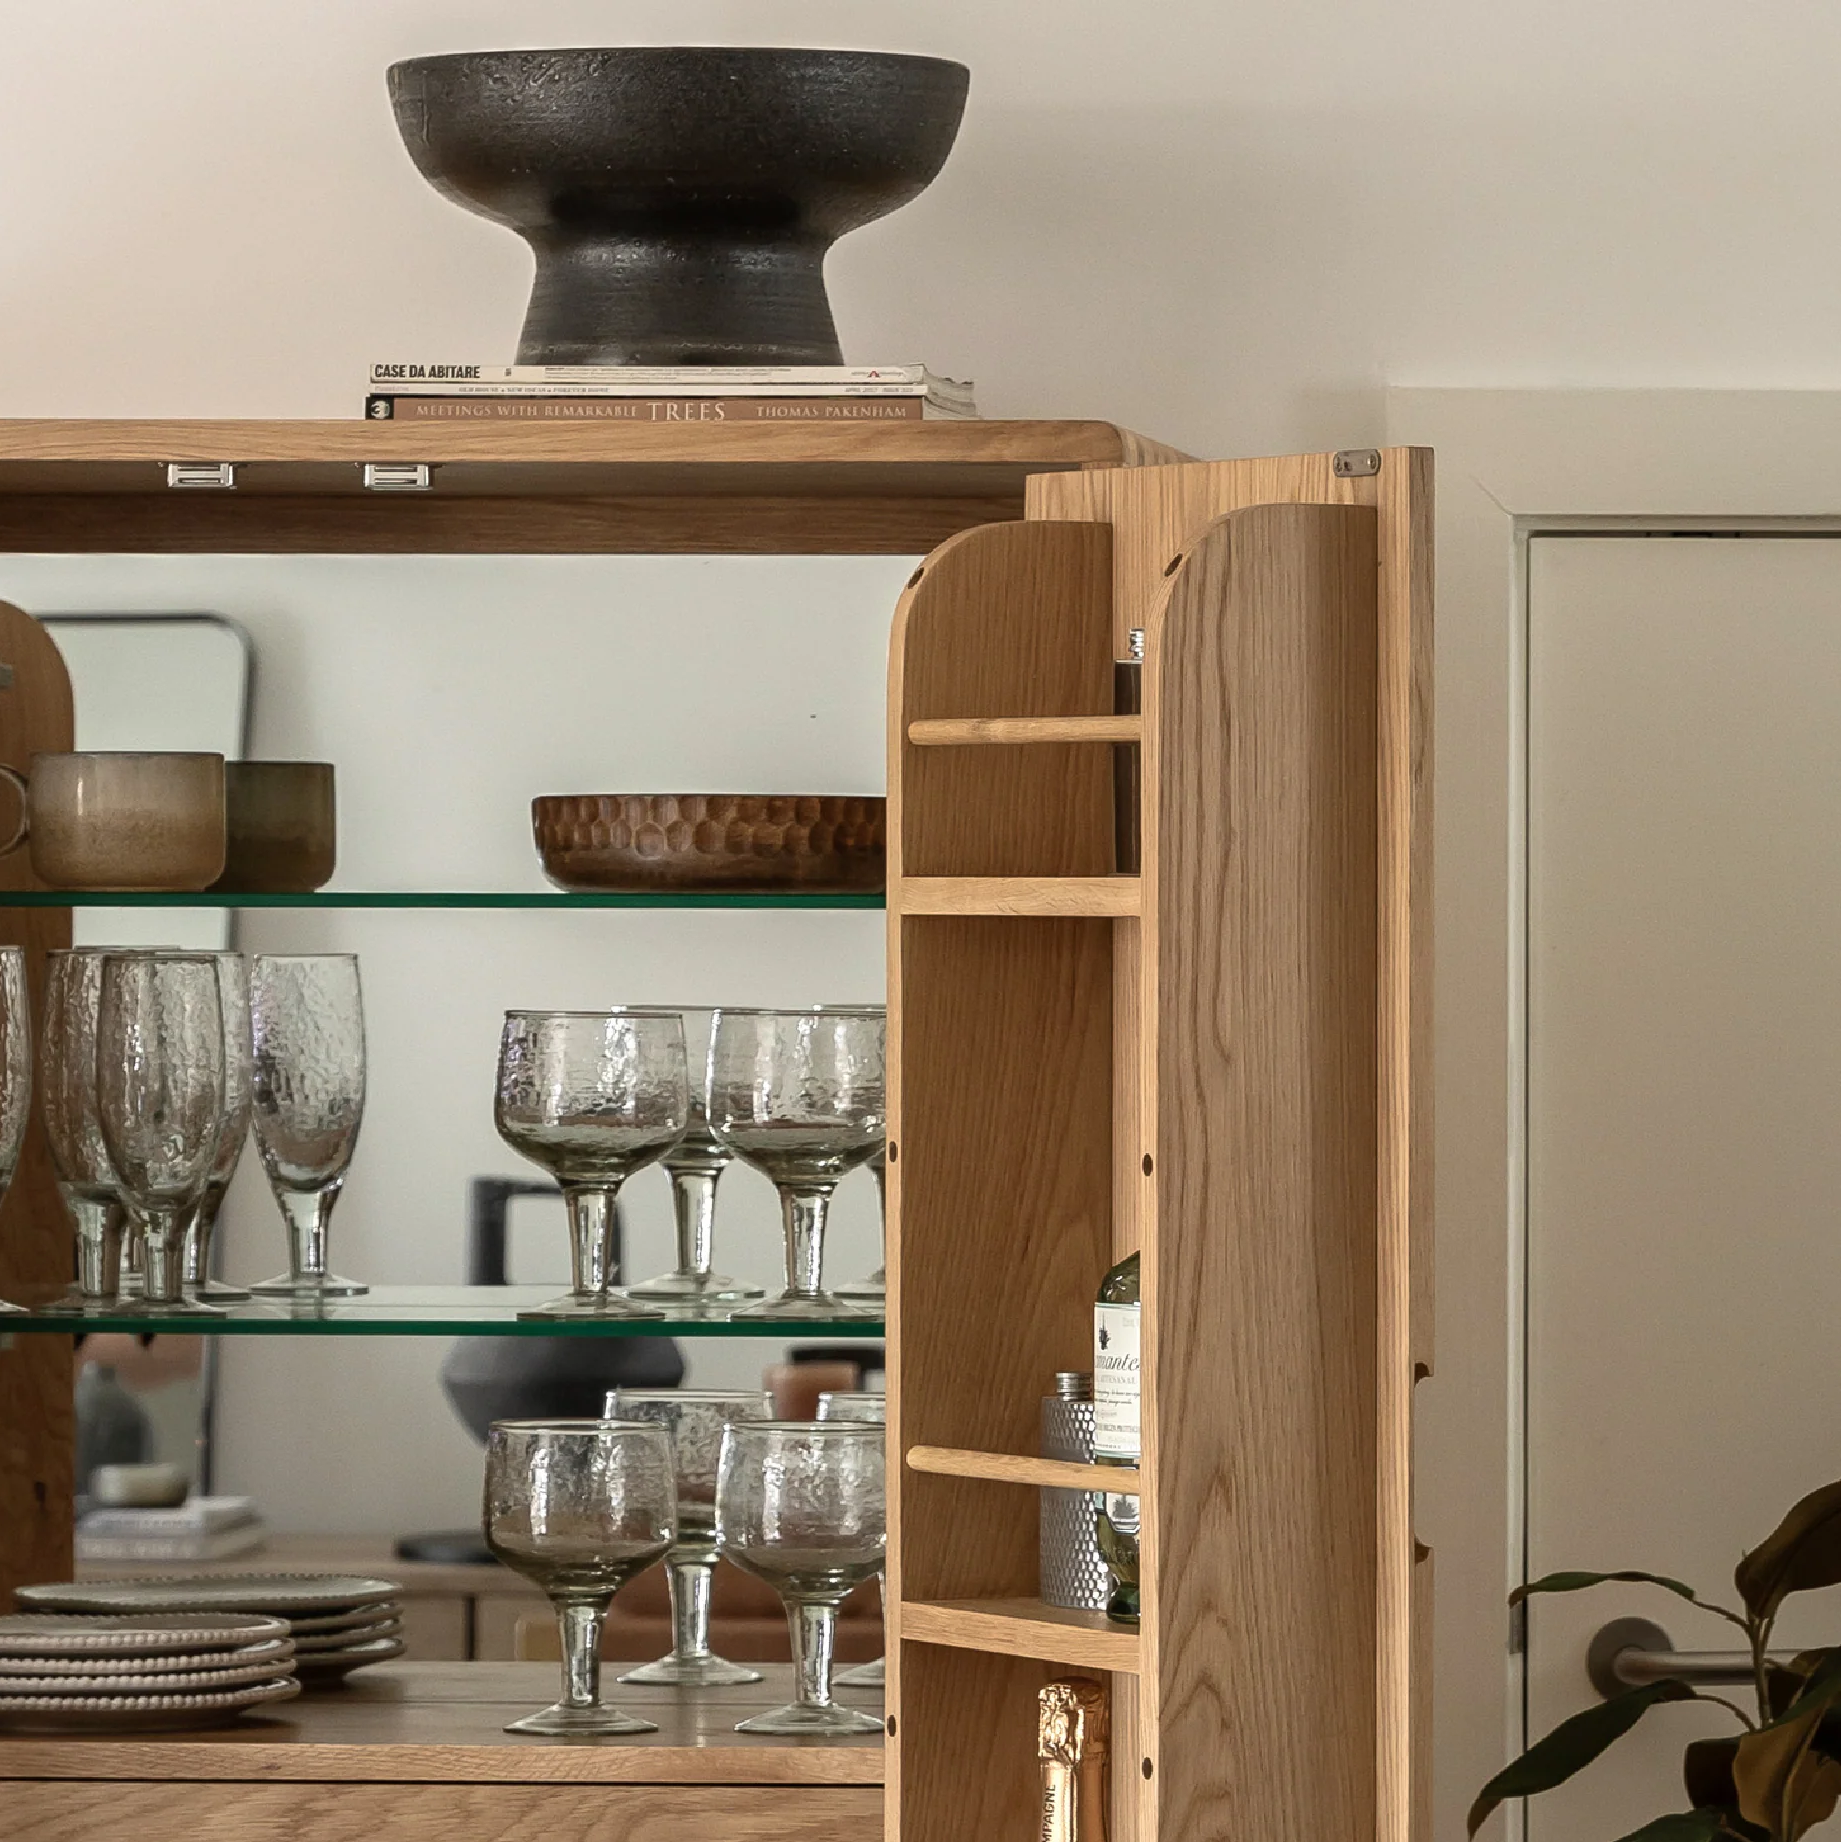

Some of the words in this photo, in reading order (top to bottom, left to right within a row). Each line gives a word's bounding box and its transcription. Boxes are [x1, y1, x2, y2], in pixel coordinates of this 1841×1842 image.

[374, 364, 406, 378] CASE
[409, 364, 425, 378] DA
[428, 364, 481, 379] ABITARE
[416, 404, 491, 417] MEETINGS
[497, 404, 538, 417] WITH
[544, 405, 637, 417] REMARKABLE
[645, 401, 726, 421] TREES
[757, 406, 819, 417] THOMAS
[825, 406, 906, 417] PAKENHAM
